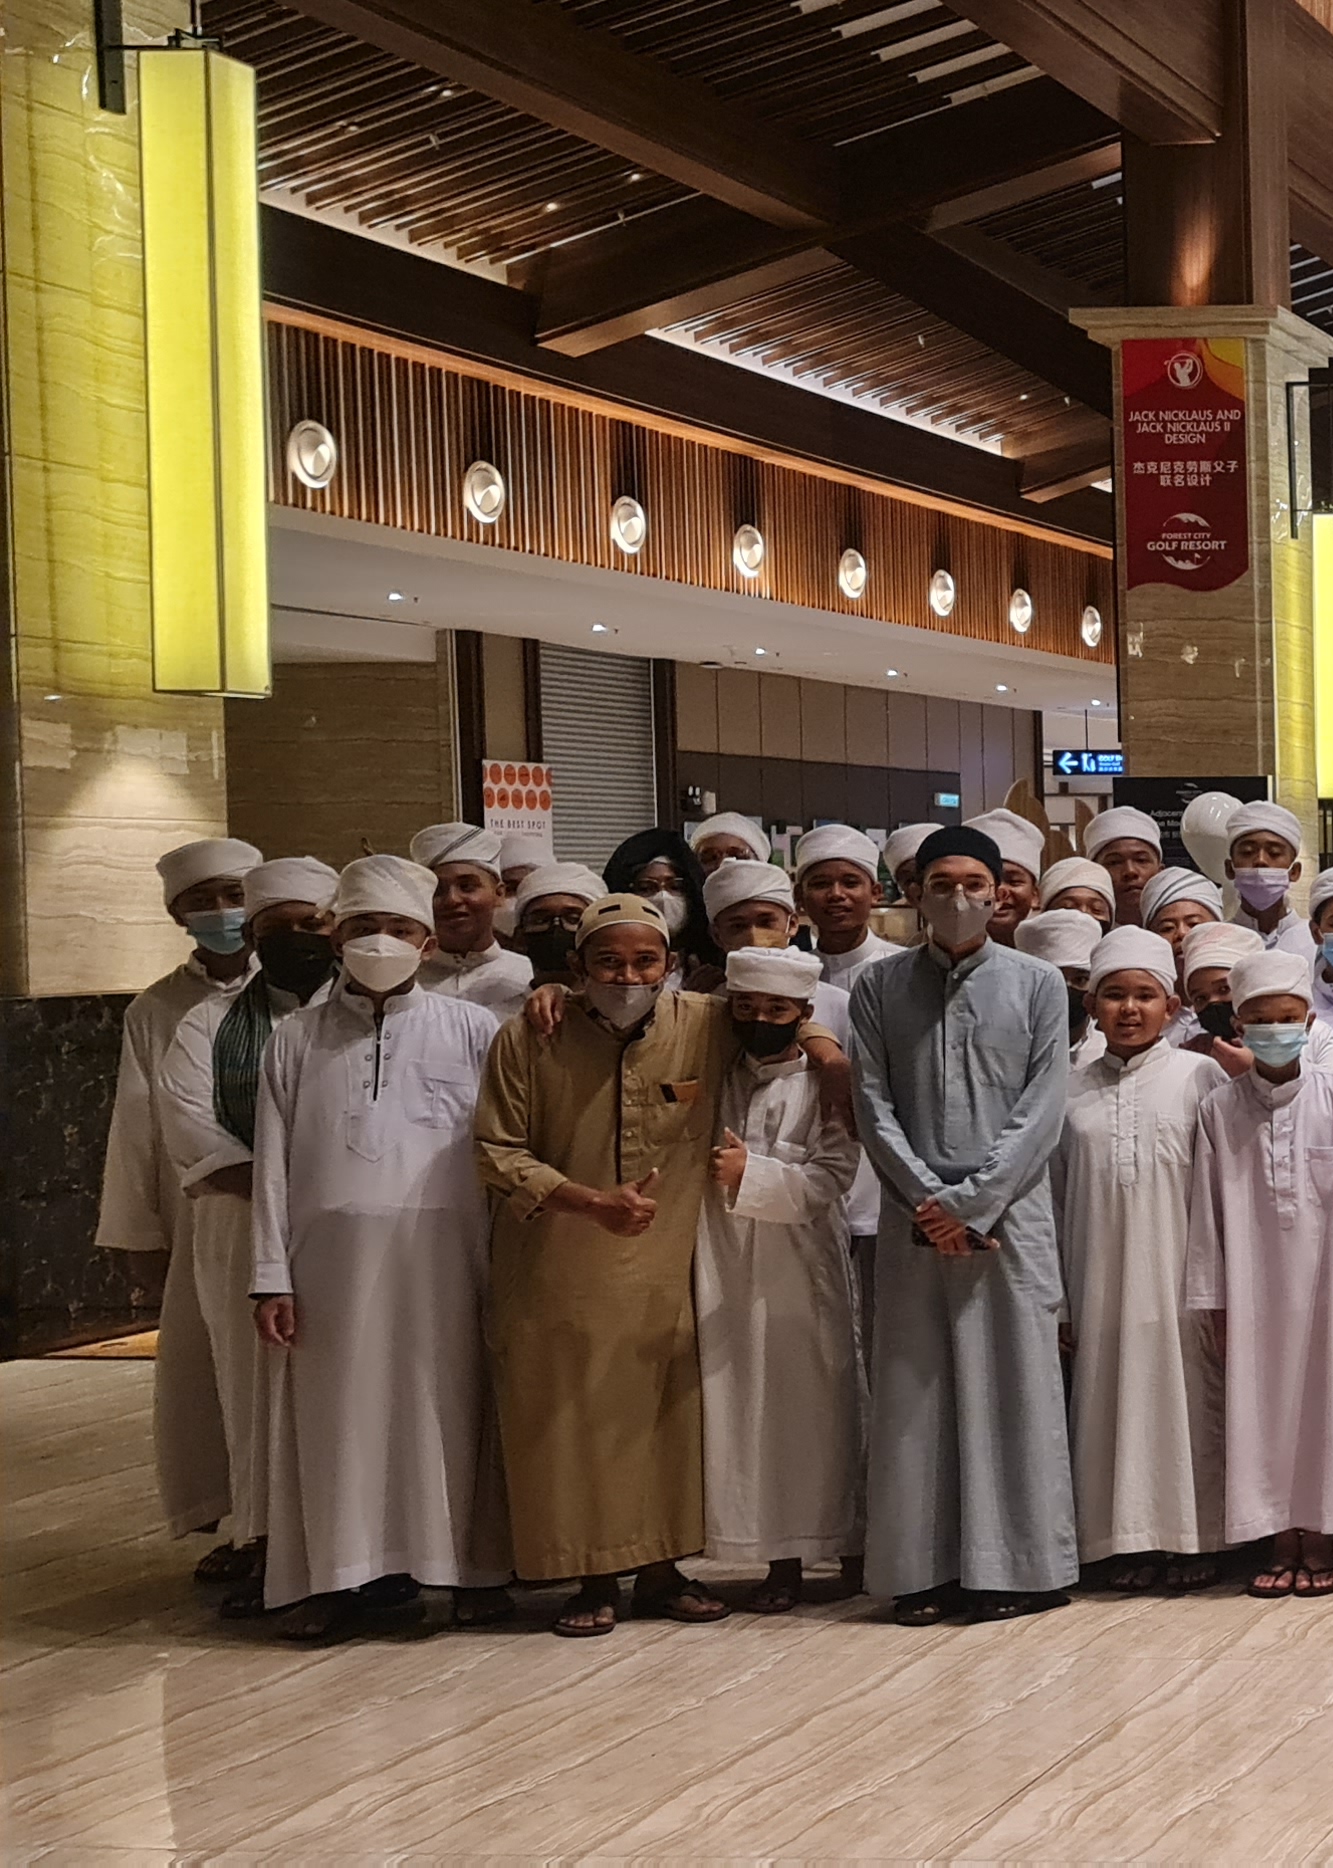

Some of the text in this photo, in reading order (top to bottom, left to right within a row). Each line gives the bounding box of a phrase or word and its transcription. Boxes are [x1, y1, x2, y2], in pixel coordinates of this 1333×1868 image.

[1128, 409, 1241, 422] JACK NICKLAUS AND
[1136, 422, 1164, 434] JACK
[1167, 421, 1221, 433] NICKLAUS
[1164, 433, 1206, 444] DESIGN
[1161, 532, 1192, 540] FOREST
[1146, 540, 1227, 551] GOLF RESORT
[1150, 809, 1184, 818] Adjacen
[490, 818, 546, 830] THE BEST SPOT
